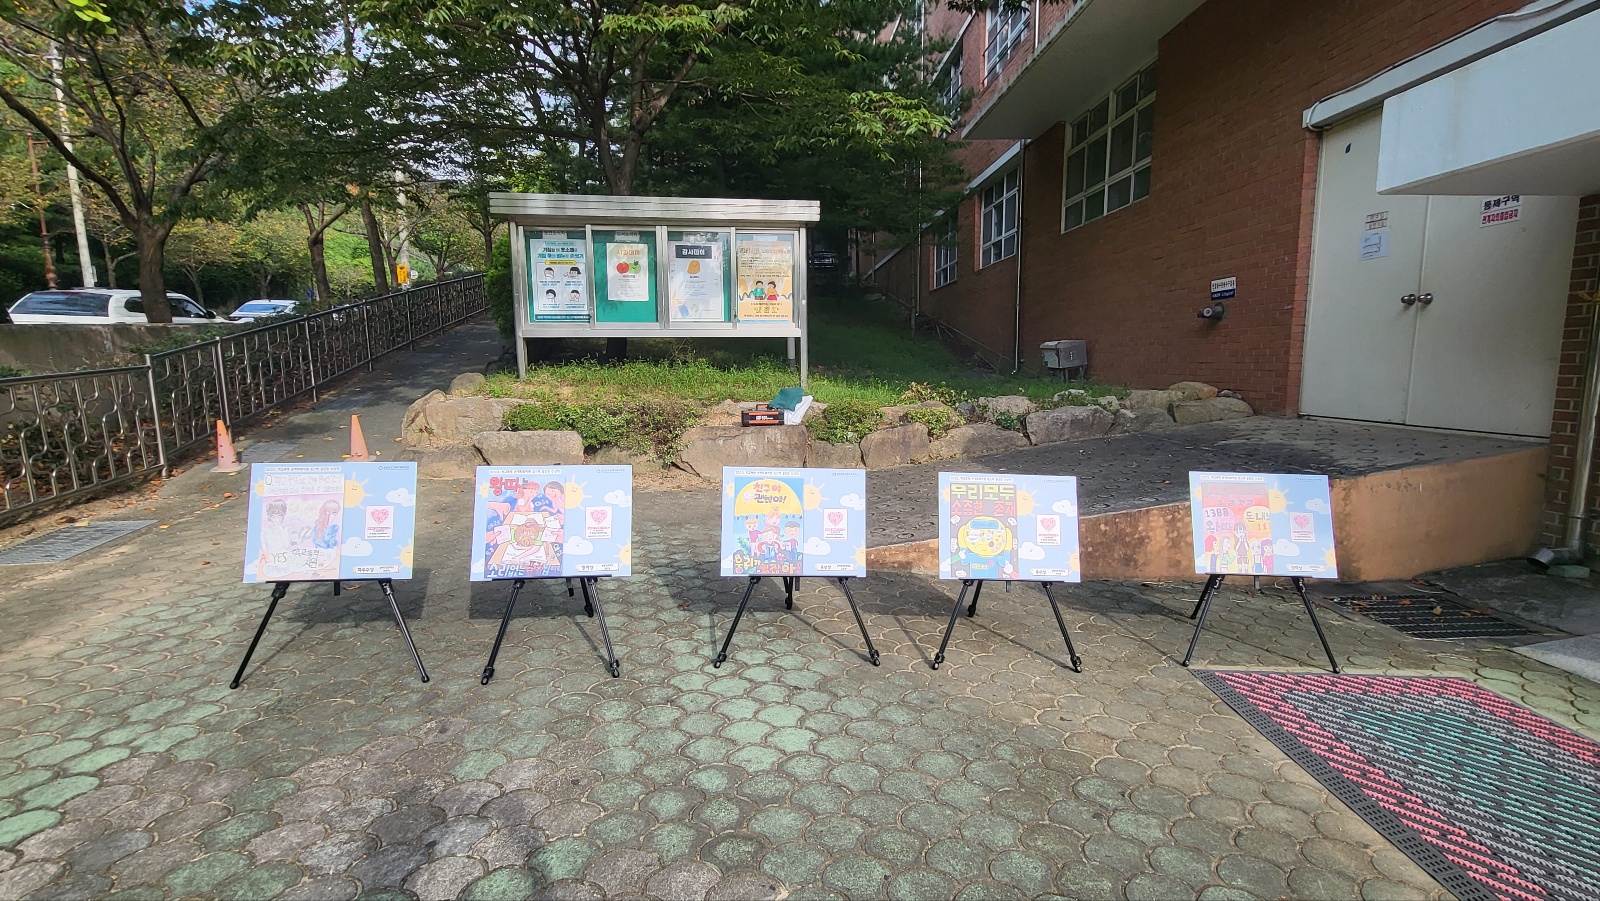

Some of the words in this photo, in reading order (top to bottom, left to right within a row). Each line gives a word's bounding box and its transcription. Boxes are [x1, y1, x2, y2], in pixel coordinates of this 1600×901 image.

[1483, 195, 1520, 211] 통제구역
[681, 248, 706, 256] 감사데이
[753, 482, 783, 493] 친구야
[950, 484, 1015, 501] 우리모두
[951, 500, 983, 517] 소중한
[993, 500, 1016, 517] 존재
[1205, 507, 1230, 518] 1388
